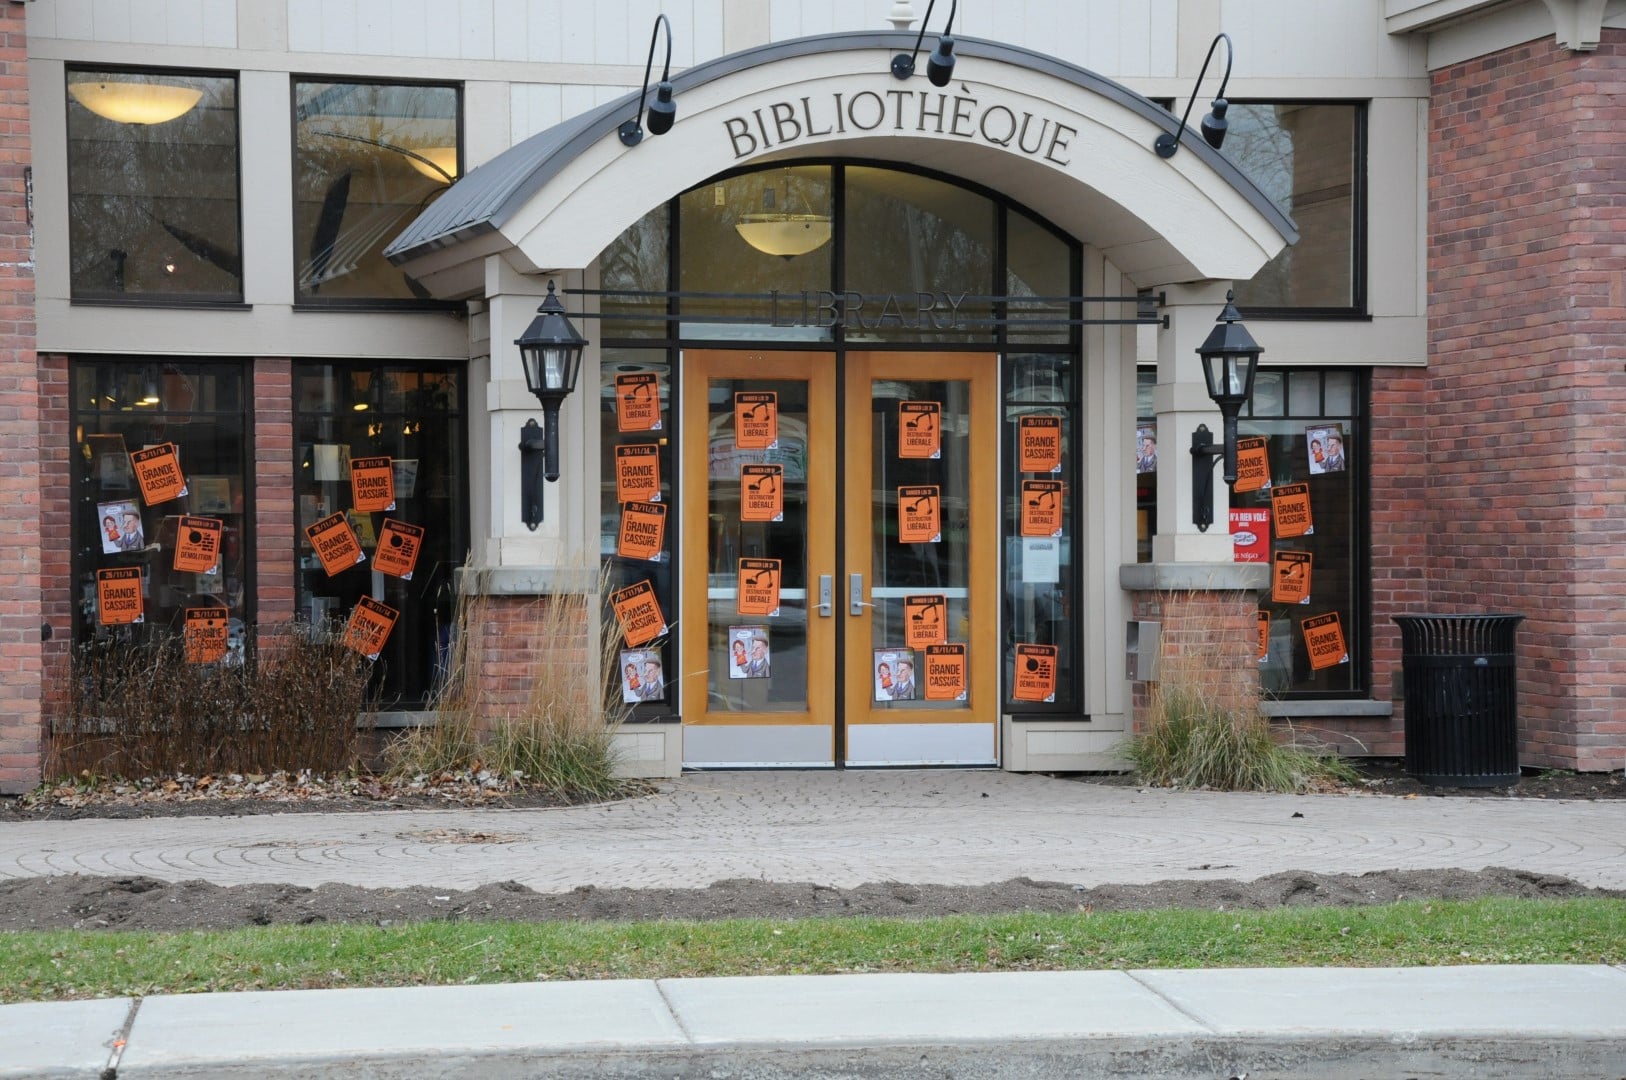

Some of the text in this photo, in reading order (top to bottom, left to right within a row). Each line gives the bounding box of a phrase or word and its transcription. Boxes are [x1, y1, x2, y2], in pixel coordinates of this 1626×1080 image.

[724, 83, 1078, 166] BIBLIOTHÈQUE
[770, 290, 969, 329] LIBRARY
[1025, 436, 1056, 447] GRANDE
[1024, 448, 1056, 459] CASSURE
[142, 463, 174, 480] GRANDE
[622, 465, 653, 476] GRANDE
[146, 475, 179, 491] CASSURE
[357, 477, 388, 488] GRANDE
[622, 477, 655, 488] CASSURE
[358, 488, 389, 499] CASSURE
[1278, 502, 1305, 514] GRANDE
[1279, 513, 1307, 525] CASSURE
[626, 521, 658, 535] GRANDE
[319, 531, 350, 553] GRANDE
[625, 533, 656, 547] CASSURE
[181, 551, 212, 560] DÉMOLITION
[324, 542, 355, 562] CASSURE
[104, 588, 137, 599] GRANDE
[104, 599, 138, 610] CASSURE
[1310, 631, 1338, 646] GRANDE
[1312, 641, 1342, 656] CASSURE
[929, 664, 960, 675] GRANDE
[929, 676, 960, 687] CASSURE
[1020, 680, 1049, 688] DÉMOLITION
